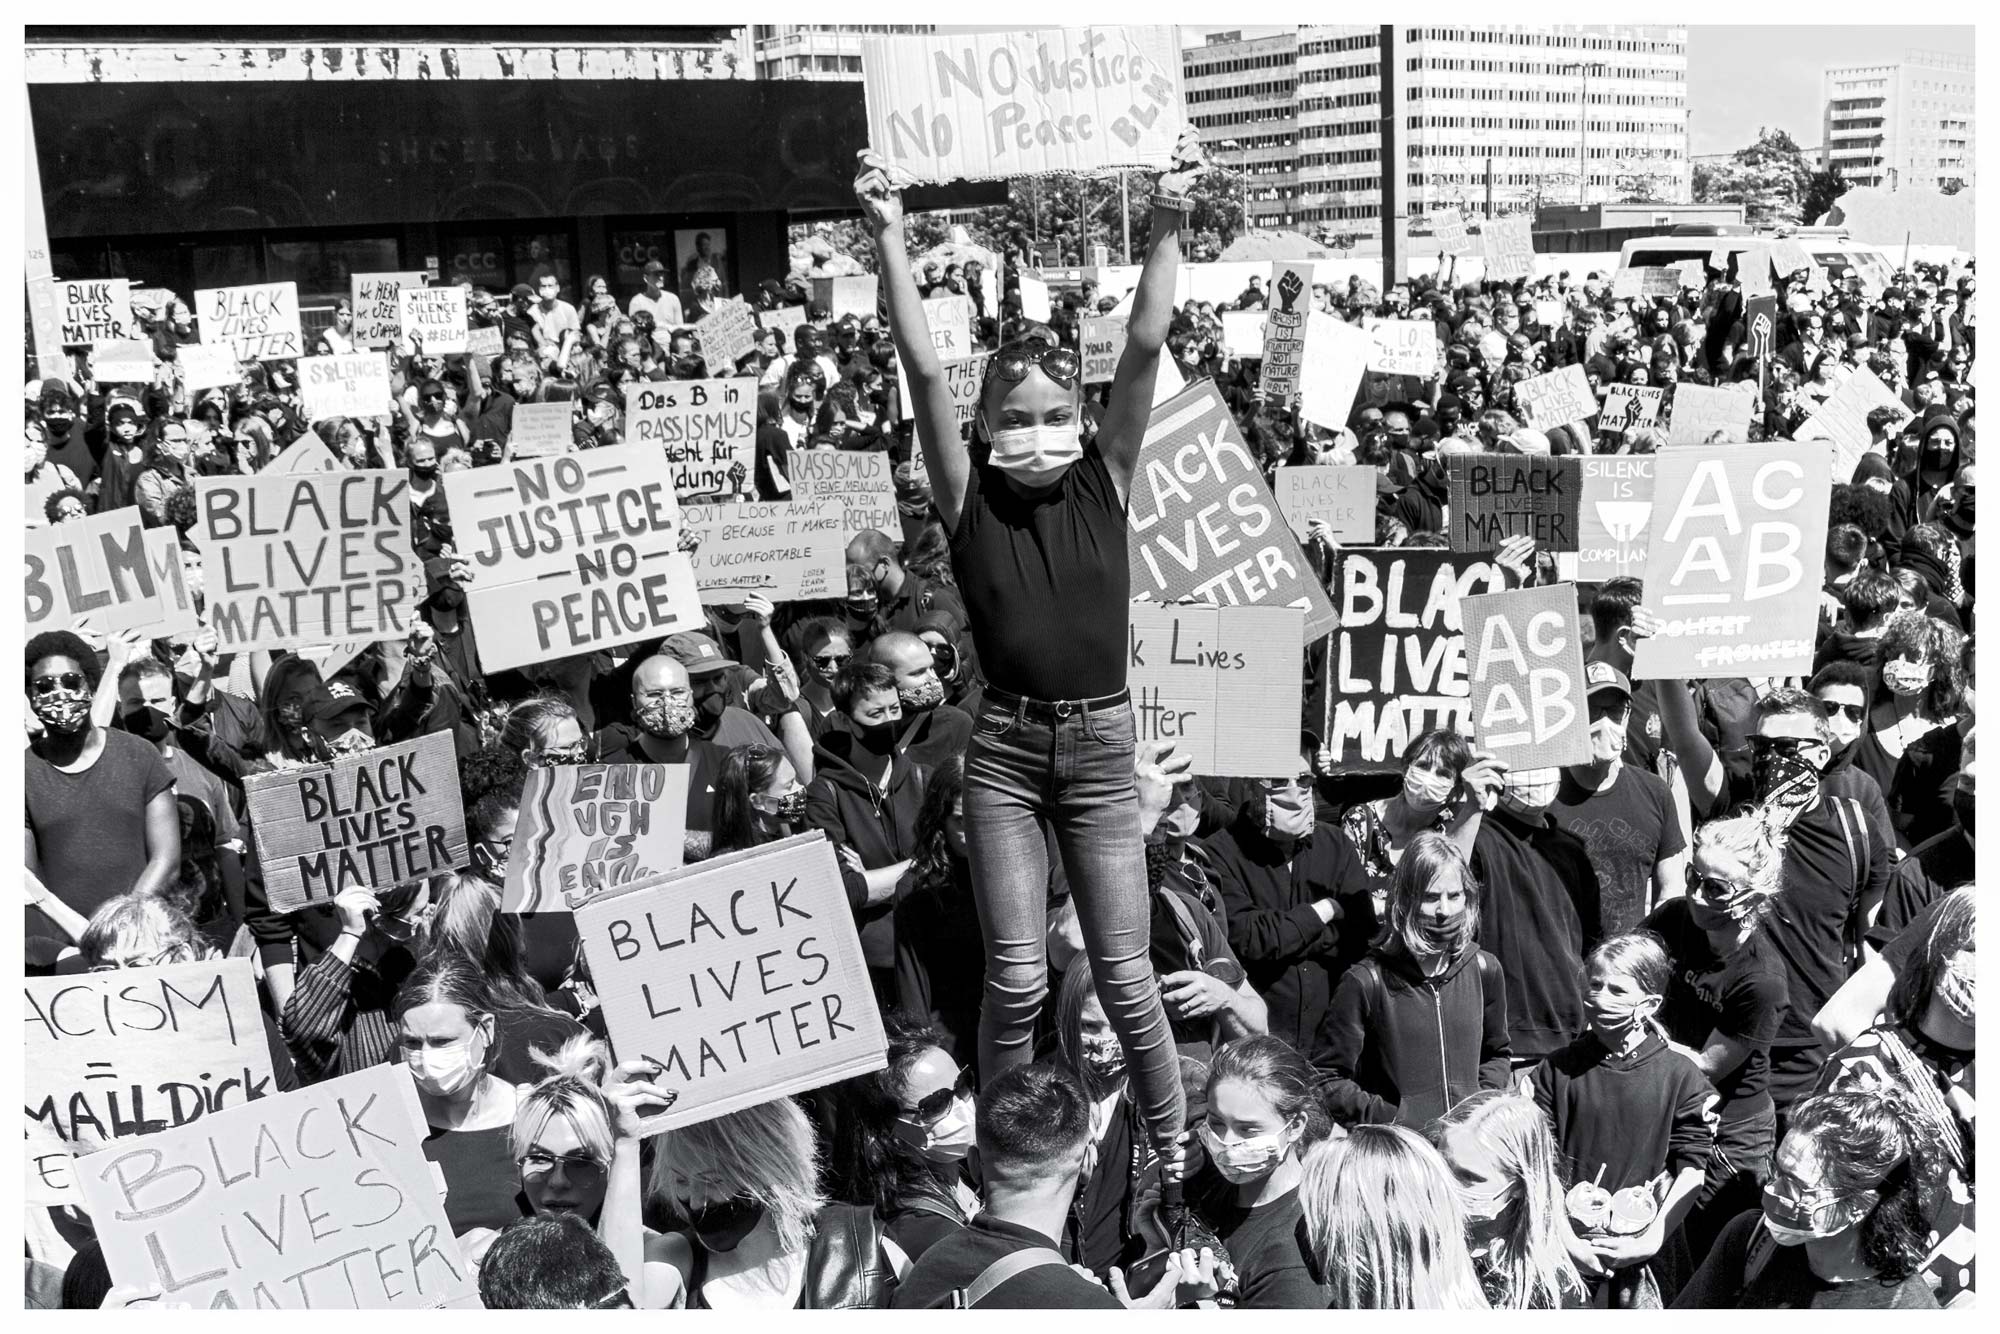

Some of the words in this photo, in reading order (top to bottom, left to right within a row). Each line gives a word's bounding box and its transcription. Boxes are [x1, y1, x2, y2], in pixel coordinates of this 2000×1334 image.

[934, 46, 1018, 99] NO
[1110, 73, 1173, 147] BLM
[886, 104, 952, 159] No
[28, 250, 45, 260] 125
[455, 253, 496, 269] CCC
[67, 284, 113, 305] BLACK
[208, 289, 282, 321] BLACK
[410, 290, 449, 302] WHITE
[66, 306, 112, 323] LIVES
[407, 302, 459, 315] SILENCE
[418, 313, 453, 325] KILLS
[1273, 312, 1299, 325] RACISM
[61, 321, 125, 343] MATTER
[221, 314, 268, 336] LIVES
[426, 329, 466, 342] #BLM
[1280, 329, 1289, 338] IS
[211, 331, 299, 363] TTER
[1085, 340, 1113, 355] YOUR
[1272, 353, 1289, 363] NOT
[344, 380, 357, 392] IS
[639, 390, 677, 410] Das
[690, 385, 708, 406] B
[724, 384, 739, 404] in
[1525, 370, 1581, 402] BLACK
[1610, 386, 1640, 398] BLACK
[1641, 387, 1661, 399] LIVES
[1543, 391, 1577, 412] LIVES
[636, 410, 754, 442] RASSISMUS
[1537, 400, 1587, 429] MATTER
[710, 440, 739, 465] für
[789, 451, 881, 481] RASSISMUS
[1127, 418, 1254, 534] LACK
[1586, 460, 1654, 479] SILENC
[795, 481, 810, 495] IST
[814, 480, 842, 495] KEINE
[844, 480, 889, 493] MEINUNG
[1290, 473, 1349, 491] BLACK
[1470, 464, 1564, 497] BLACK
[1613, 482, 1634, 498] IS
[204, 475, 407, 541] BLACK
[737, 504, 778, 520] LOOK
[785, 502, 826, 518] AWAY
[859, 494, 878, 506] EIN
[1291, 496, 1335, 509] LIVES
[1494, 495, 1543, 511] LIVES
[475, 482, 672, 568] JUSTICE
[1291, 508, 1357, 523] MATTER
[1464, 510, 1570, 544] MATTER
[722, 524, 775, 541] BECAUSE
[786, 521, 798, 535] IT
[801, 518, 840, 533] MAKES
[1139, 483, 1272, 590] IVES
[221, 530, 404, 593] LIVES
[710, 546, 812, 568] UNCOMFORTABLE
[1579, 548, 1648, 564] COMPLIAN
[705, 577, 728, 587] LIVES
[211, 578, 405, 645] MATTER
[532, 573, 678, 651] PEACE
[1170, 618, 1246, 670] Lives
[1694, 639, 1813, 668] FRONTEX
[1338, 631, 1472, 697] LIVE
[1138, 686, 1197, 741] tter
[298, 750, 427, 823] BLACK
[320, 801, 416, 850] LIVES
[298, 823, 454, 901] MATTER
[608, 876, 813, 962] BLACK
[641, 936, 830, 1020] LIVES
[640, 993, 856, 1082] MATTER
[99, 1092, 397, 1222] BLACK
